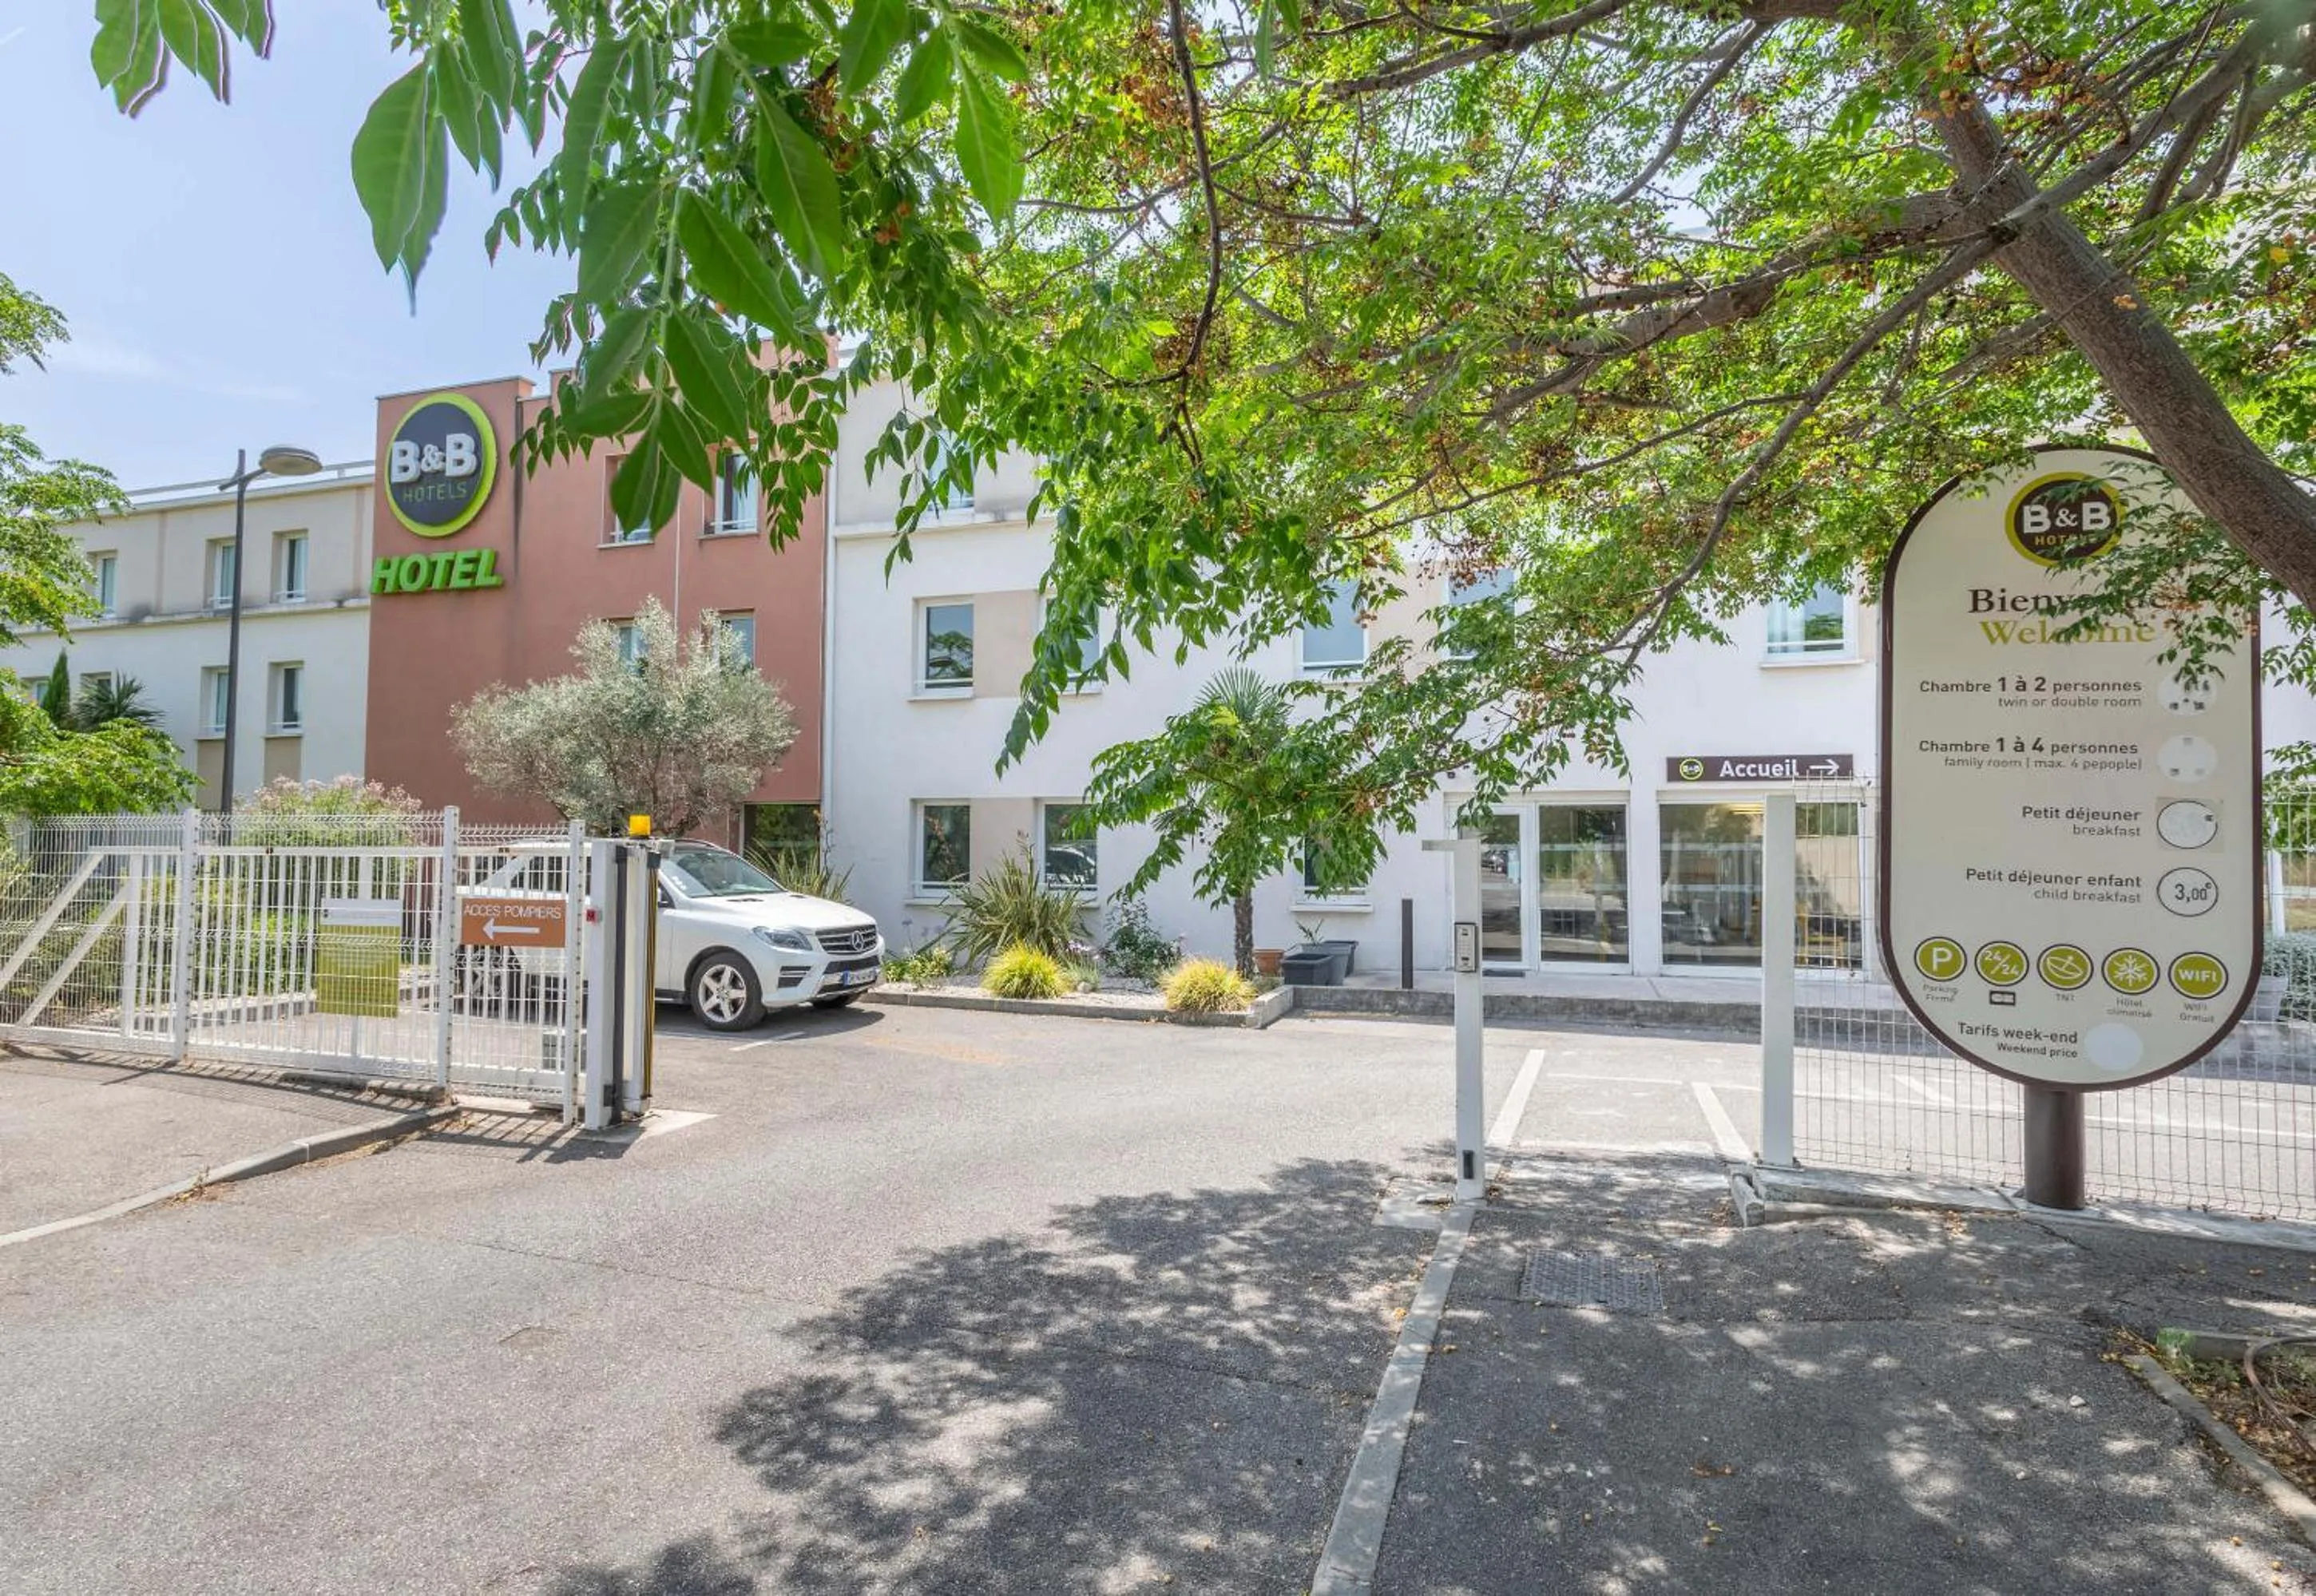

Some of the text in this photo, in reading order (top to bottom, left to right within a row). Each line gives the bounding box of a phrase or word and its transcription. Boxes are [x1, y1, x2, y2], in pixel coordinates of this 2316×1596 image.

[391, 433, 478, 483] B&B
[403, 481, 467, 503] HOTELS
[2023, 501, 2111, 533] B&B
[371, 548, 504, 594] HOTEL
[1979, 617, 2155, 646] Welome
[1919, 675, 2142, 695] Chambre 1 à 2 personnes
[1998, 696, 2142, 707] twin or double room
[1919, 735, 2139, 756] Chambre 1 à 4 personnes
[1719, 759, 1799, 778] Accueil
[1945, 757, 1983, 769] family
[1988, 759, 2022, 768] room
[2070, 758, 2078, 769] 4
[2021, 806, 2142, 823] Petit déjeuner
[2072, 824, 2141, 837] breakfast
[1966, 868, 2142, 889] Petit déjeuner enfant
[2034, 889, 2141, 905] child breakfast
[464, 905, 561, 920] ACCES POMPIERS
[1932, 946, 1953, 972] P
[1957, 1022, 2078, 1044] Tarifs week-end
[1997, 1043, 2079, 1059] Weekend price
